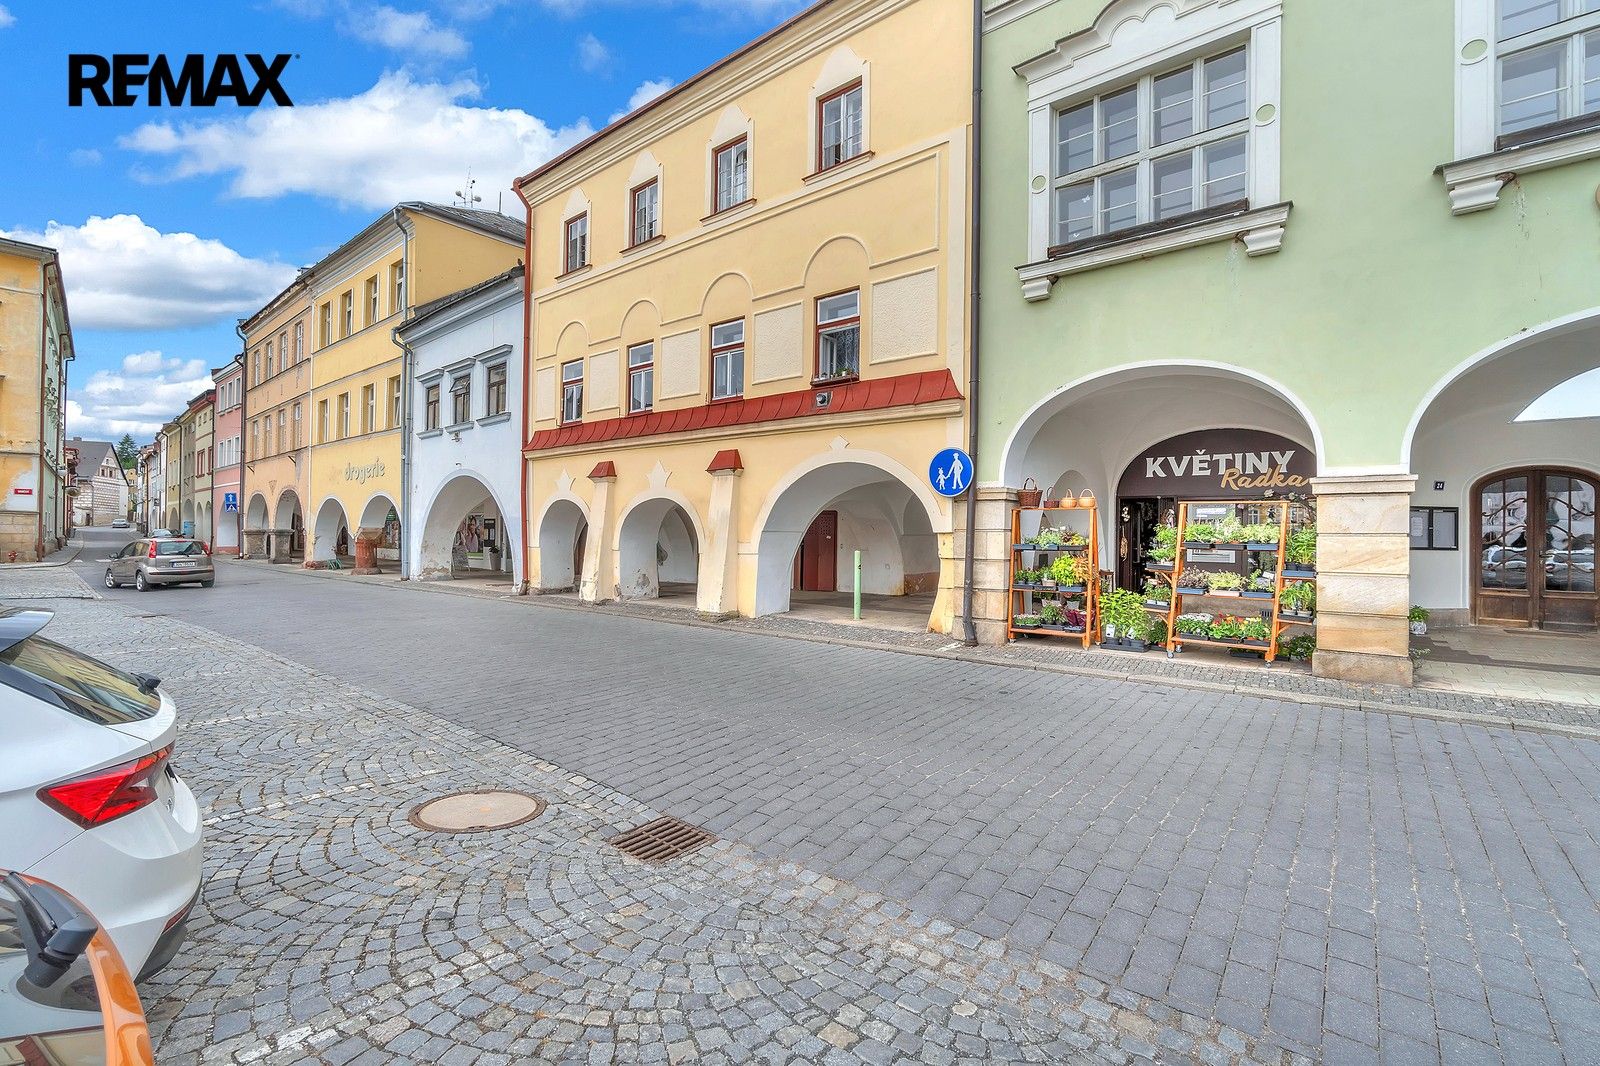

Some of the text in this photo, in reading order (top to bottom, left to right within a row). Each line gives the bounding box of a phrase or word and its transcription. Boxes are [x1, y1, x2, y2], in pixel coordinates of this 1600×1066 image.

[344, 457, 386, 485] drogerie
[1146, 450, 1296, 478] KVĚTINY
[1220, 464, 1309, 491] Radka
